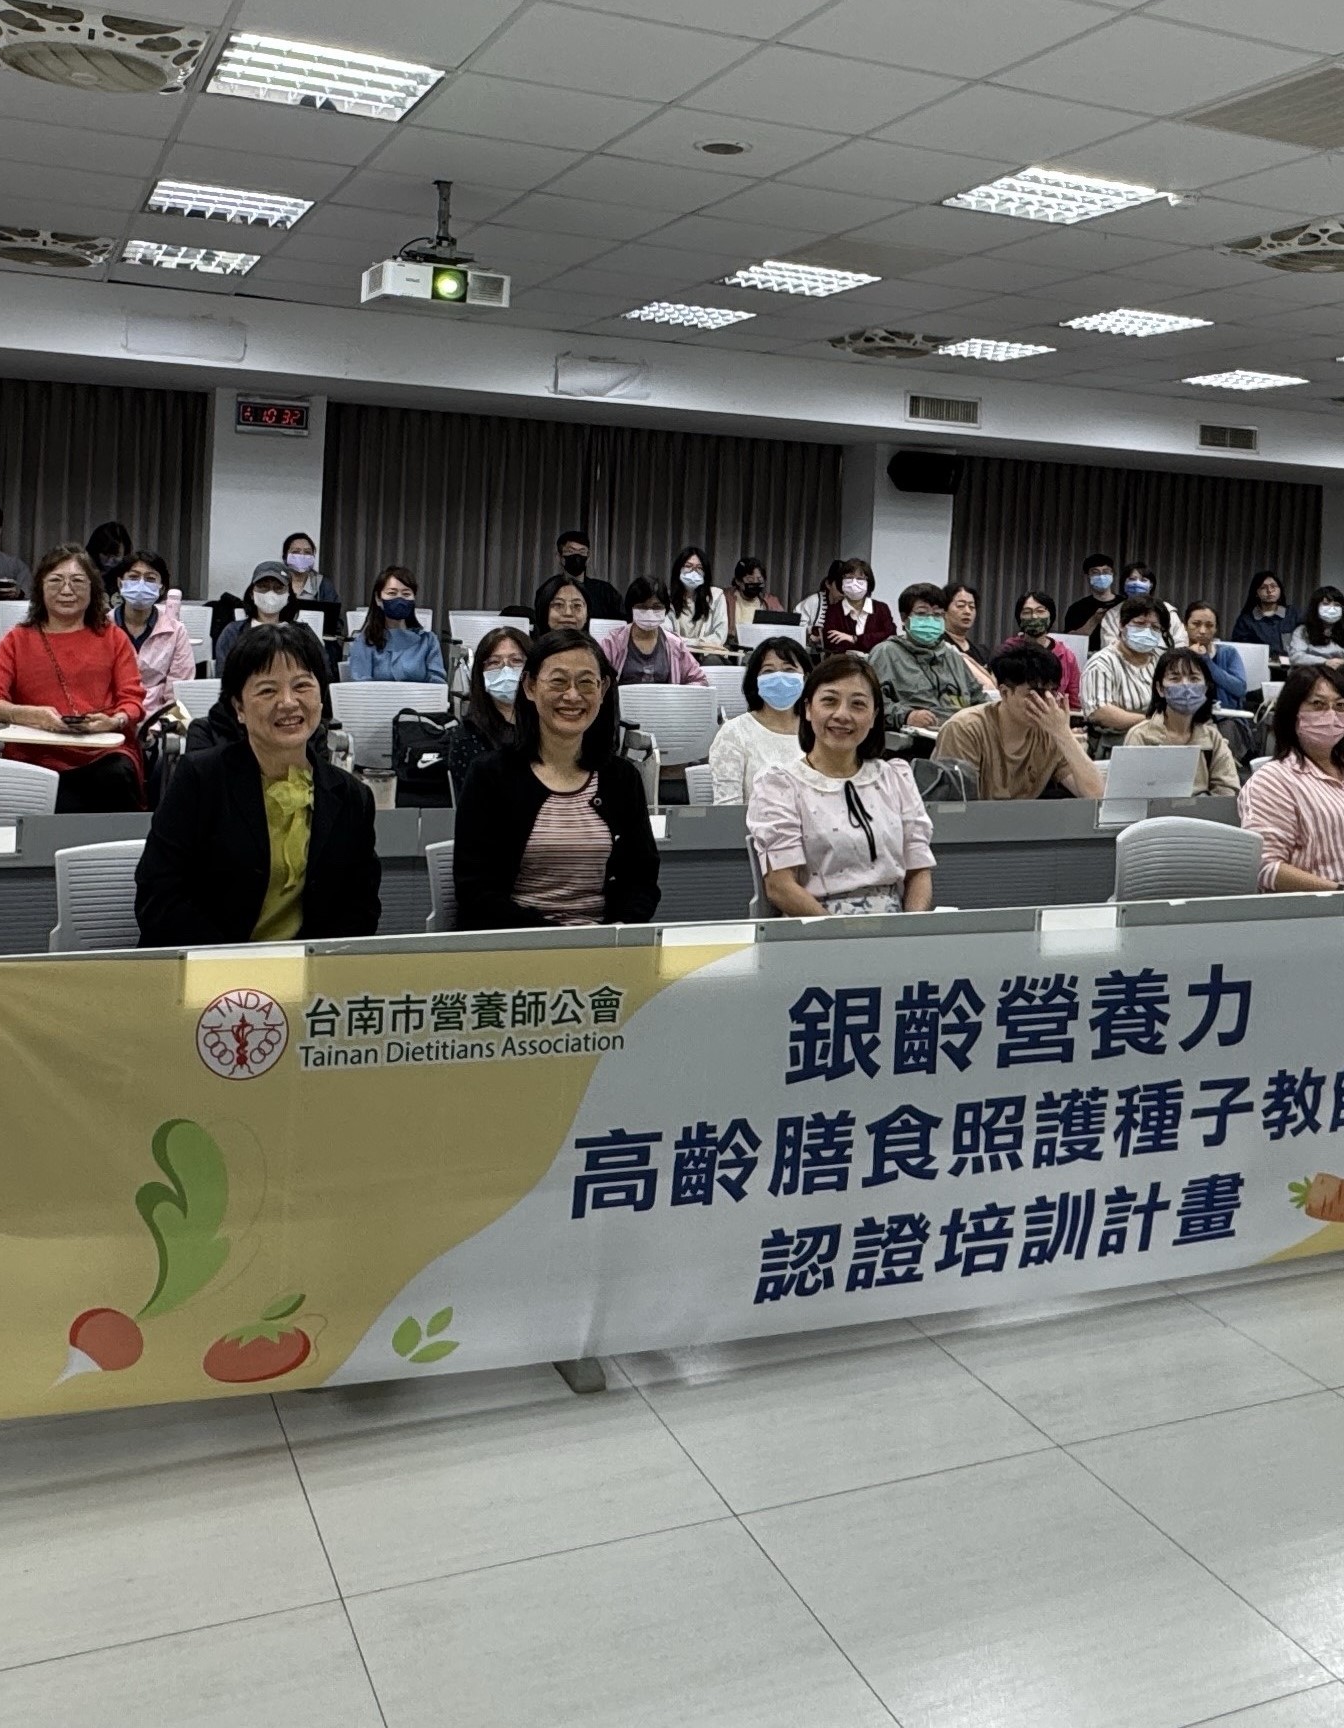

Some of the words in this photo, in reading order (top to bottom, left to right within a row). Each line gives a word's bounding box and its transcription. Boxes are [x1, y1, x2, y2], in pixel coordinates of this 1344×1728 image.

[208, 991, 274, 1020] TNDA
[305, 985, 624, 1038] 台南市營養師公會
[785, 963, 1254, 1085] 銀齡營養力
[299, 1045, 378, 1067] Tainan
[387, 1038, 495, 1063] Dietitians
[501, 1031, 624, 1057] Association
[753, 1173, 1246, 1304] 認證培訓計畫
